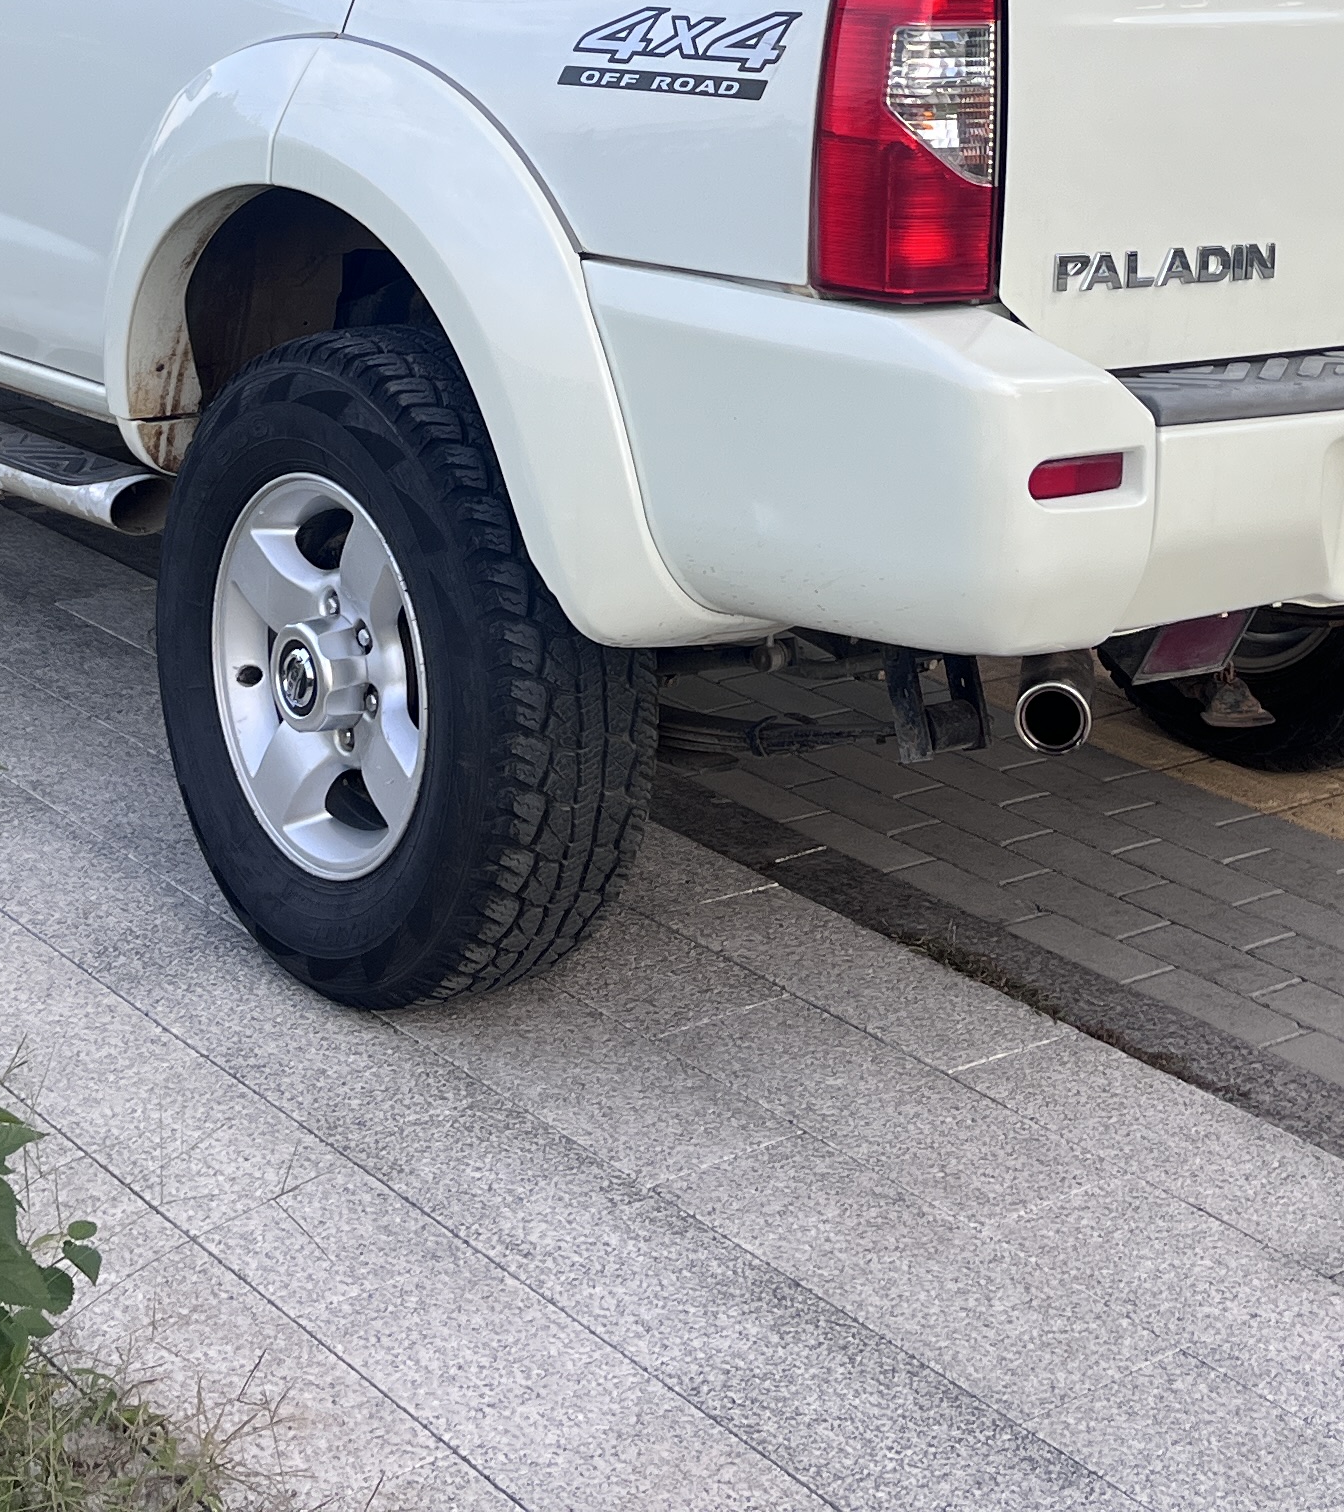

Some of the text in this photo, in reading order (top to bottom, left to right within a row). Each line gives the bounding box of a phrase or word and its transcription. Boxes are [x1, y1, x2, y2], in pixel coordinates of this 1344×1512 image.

[580, 70, 740, 96] OFF ROAD
[1053, 242, 1276, 292] PALADIN
